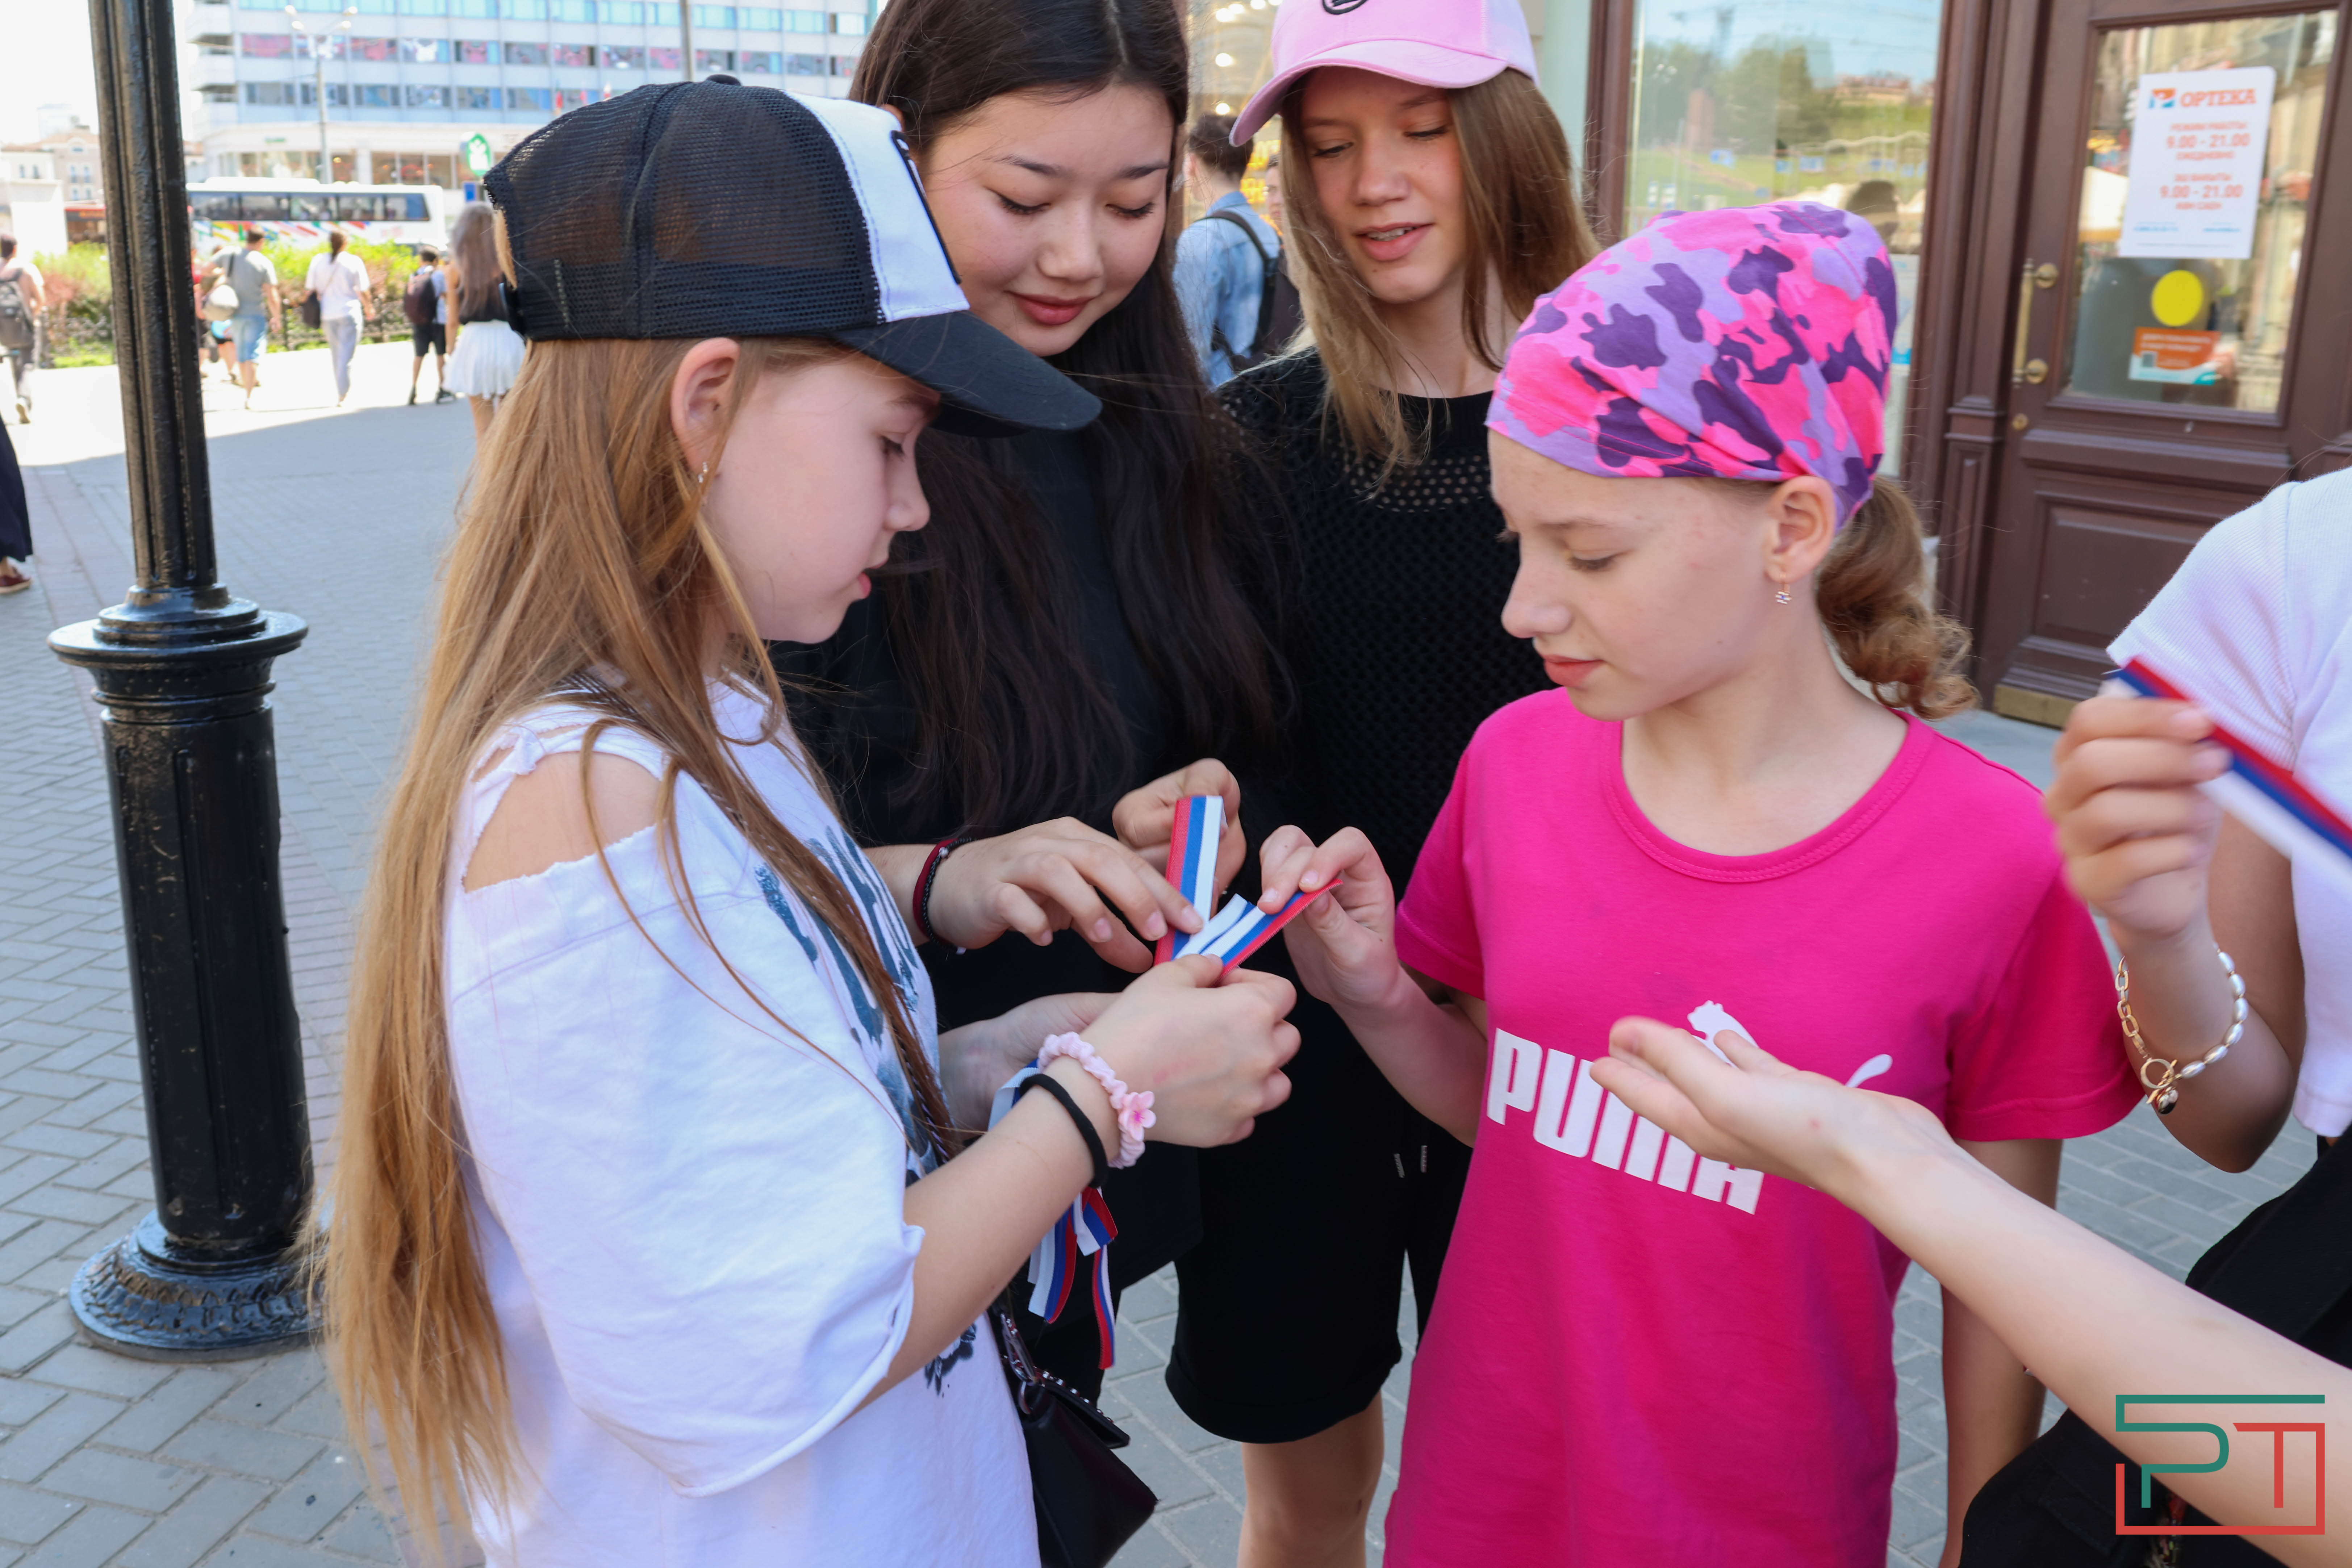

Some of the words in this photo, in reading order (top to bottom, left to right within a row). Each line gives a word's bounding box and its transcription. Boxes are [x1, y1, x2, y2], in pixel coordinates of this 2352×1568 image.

[2167, 135, 2197, 148] 9.00
[2209, 133, 2251, 147] 21.00
[2160, 185, 2190, 198] 9.00
[2202, 184, 2243, 198] 21.00
